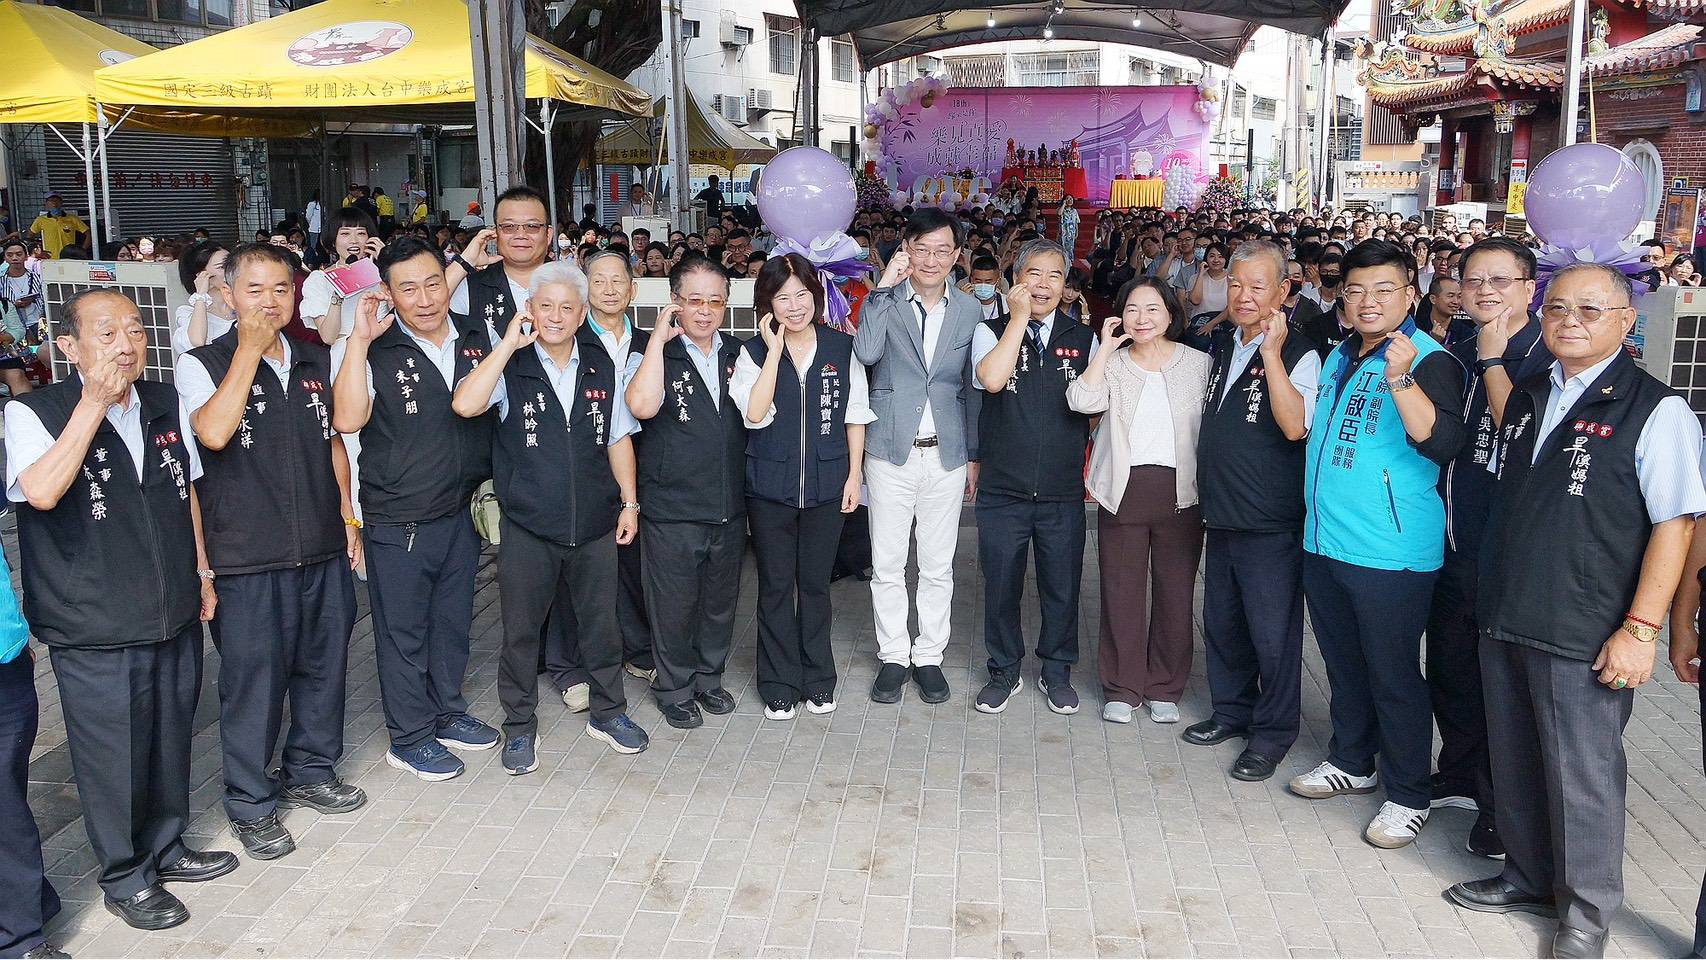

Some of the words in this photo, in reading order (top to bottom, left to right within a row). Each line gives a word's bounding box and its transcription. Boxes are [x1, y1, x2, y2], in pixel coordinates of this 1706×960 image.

[164, 83, 273, 99] 國定三級古蹟
[304, 81, 470, 99] 財團法人台中樂成宮
[252, 384, 267, 414] 監事
[1473, 416, 1491, 465] 吳忠聖
[1513, 412, 1532, 440] 董事
[94, 447, 112, 482] 董事
[1563, 436, 1591, 497] 旱溪媽祖
